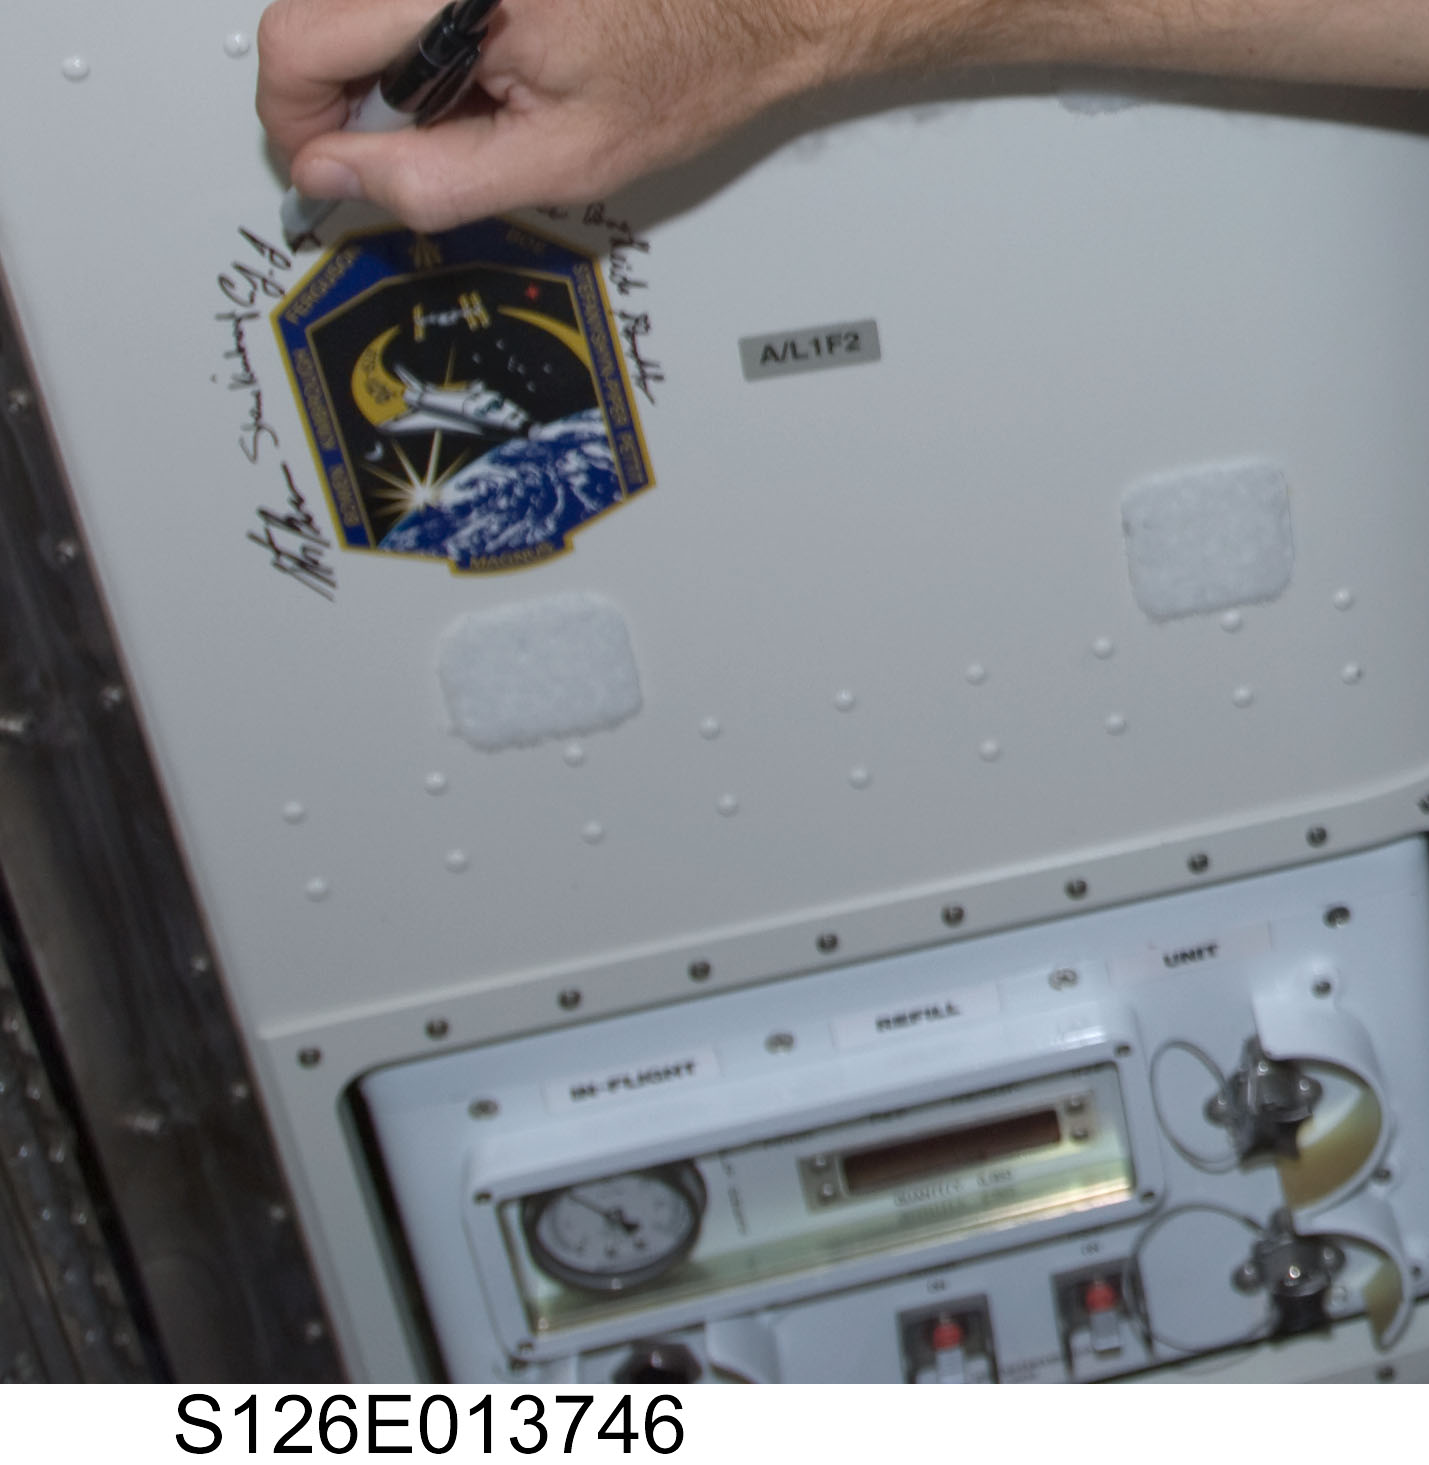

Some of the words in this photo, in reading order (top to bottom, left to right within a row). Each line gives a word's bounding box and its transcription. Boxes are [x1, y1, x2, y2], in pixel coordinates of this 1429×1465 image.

[760, 332, 861, 365] A/L1F2
[875, 1000, 963, 1033] REFILL
[1162, 941, 1220, 968] UNIT
